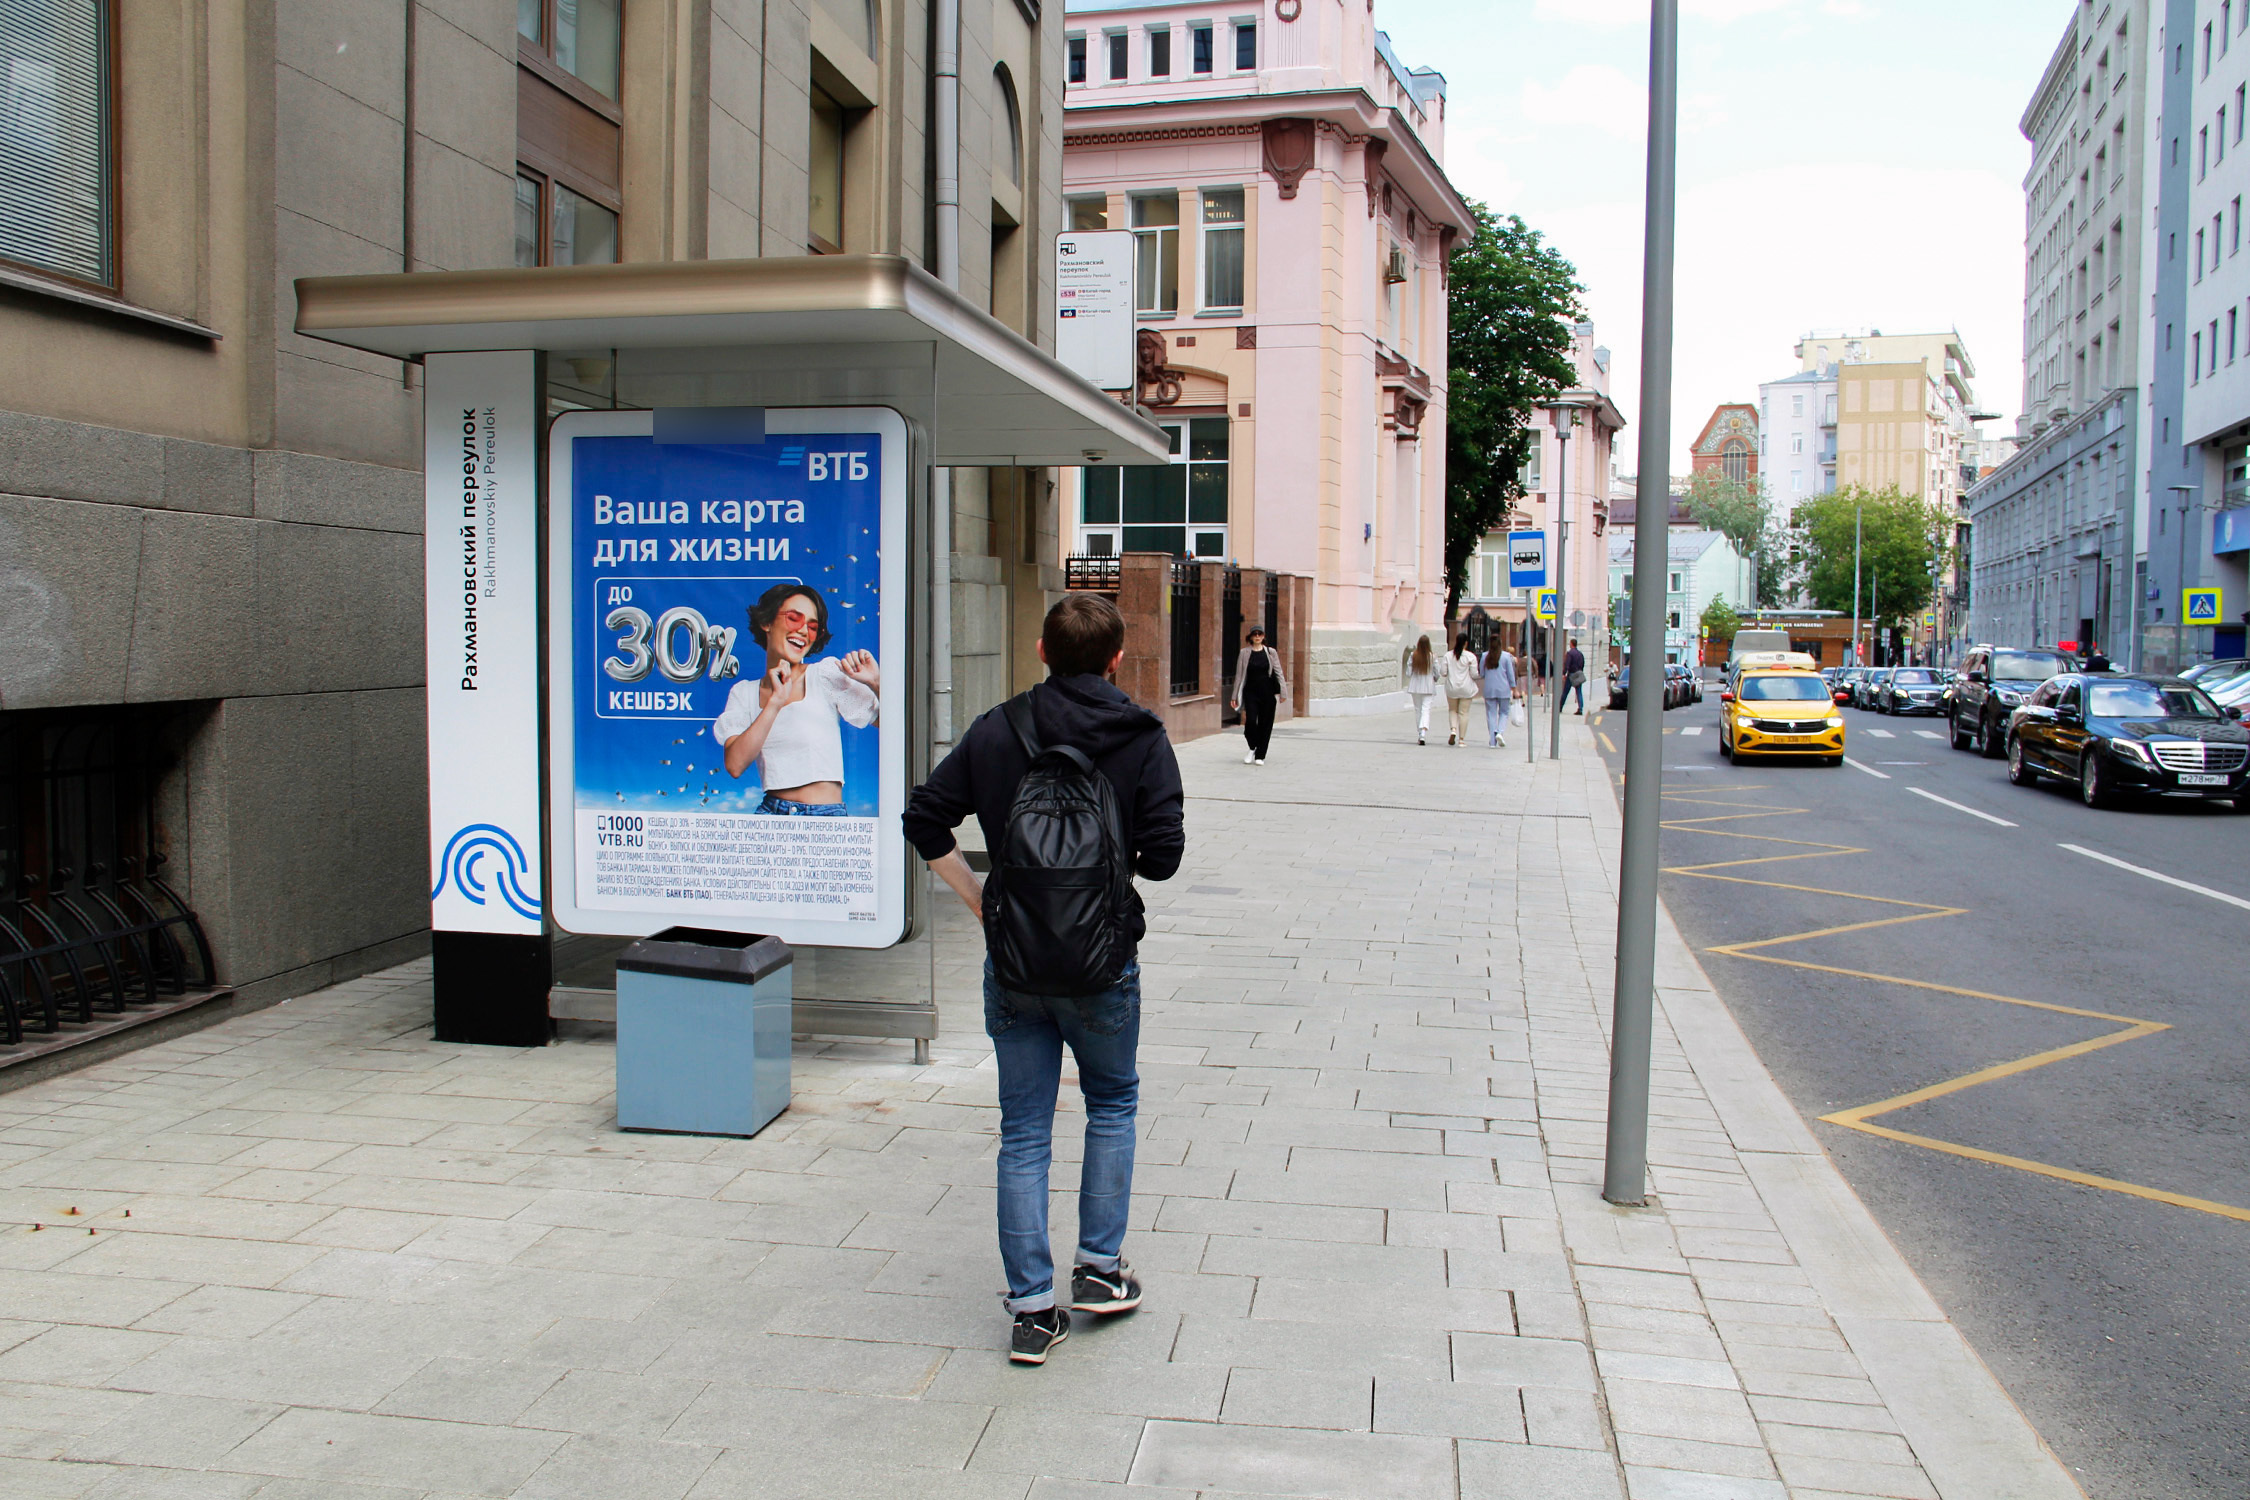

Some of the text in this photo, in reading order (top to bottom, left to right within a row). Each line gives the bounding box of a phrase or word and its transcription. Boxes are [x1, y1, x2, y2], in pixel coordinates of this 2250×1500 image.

[808, 452, 869, 481] ВТБ
[482, 407, 498, 598] Rakhmanovskiy Pereulok
[594, 494, 805, 532] Ваша карта
[460, 408, 480, 691] Рахмановский переулок
[593, 538, 790, 567] для жизни
[607, 586, 633, 605] ДО
[603, 606, 740, 684] 30%
[609, 691, 693, 711] КЕШБЭК
[608, 816, 643, 832] 1000
[598, 833, 644, 847] VTB.RU
